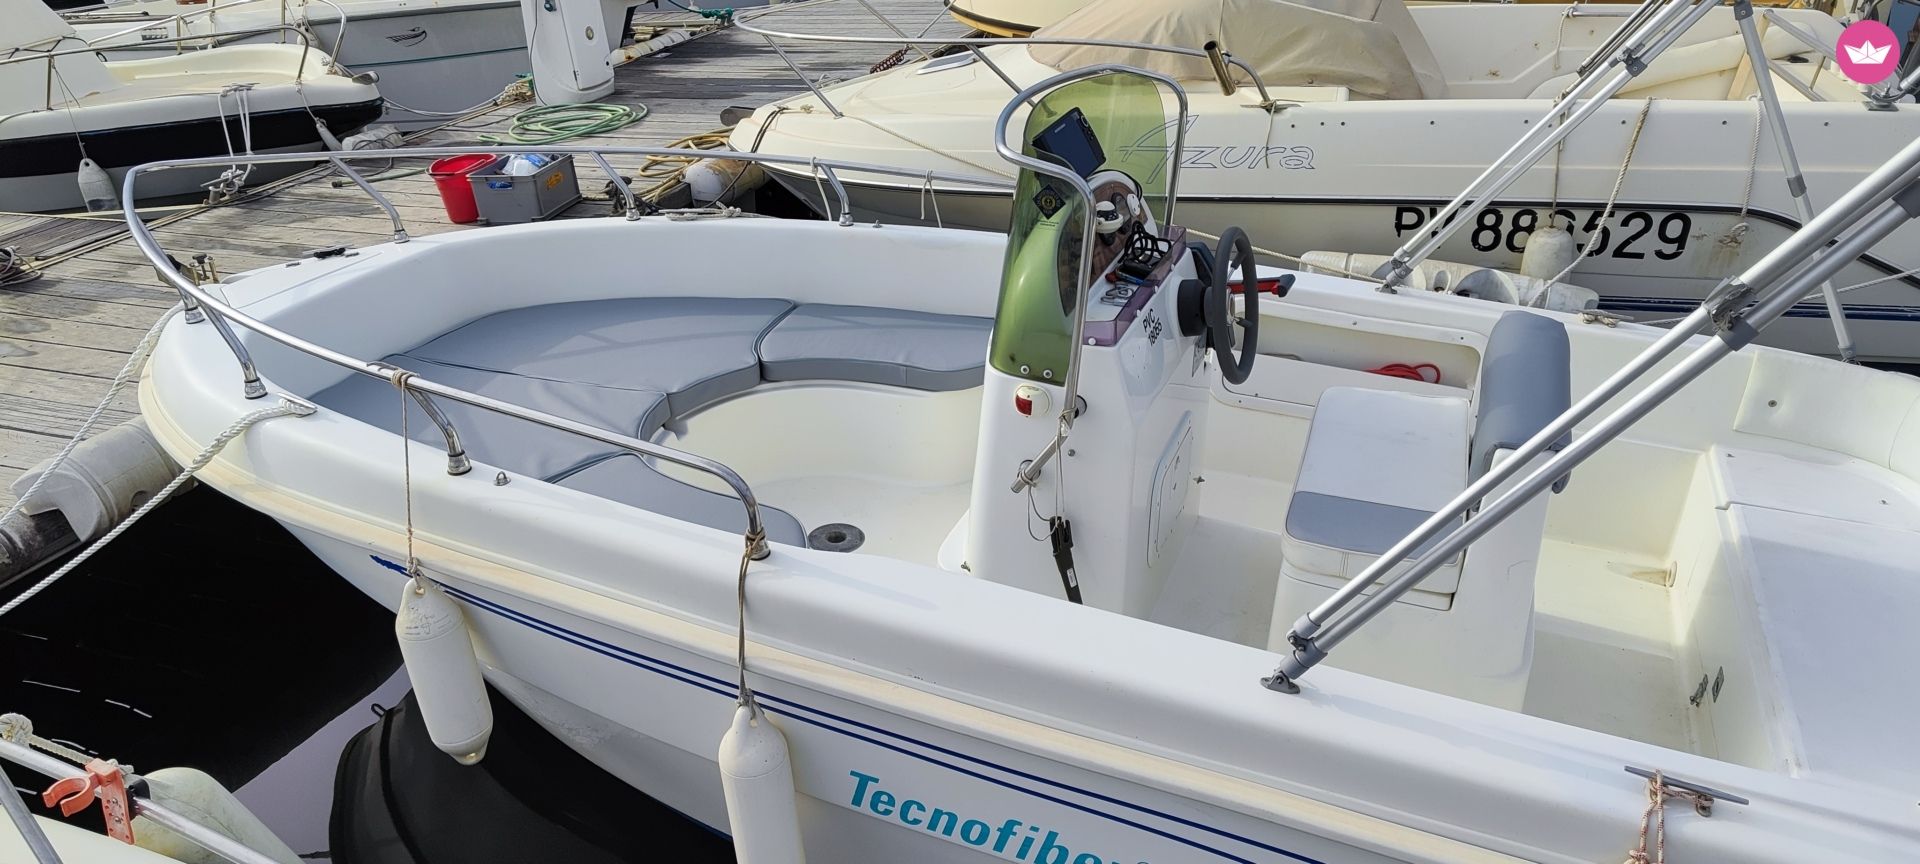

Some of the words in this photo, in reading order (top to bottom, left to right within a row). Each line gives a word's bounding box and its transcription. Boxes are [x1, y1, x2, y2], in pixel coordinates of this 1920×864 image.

[1119, 114, 1315, 184] Azura
[1142, 308, 1156, 333] PVC
[849, 770, 1120, 864] Tecnofib
